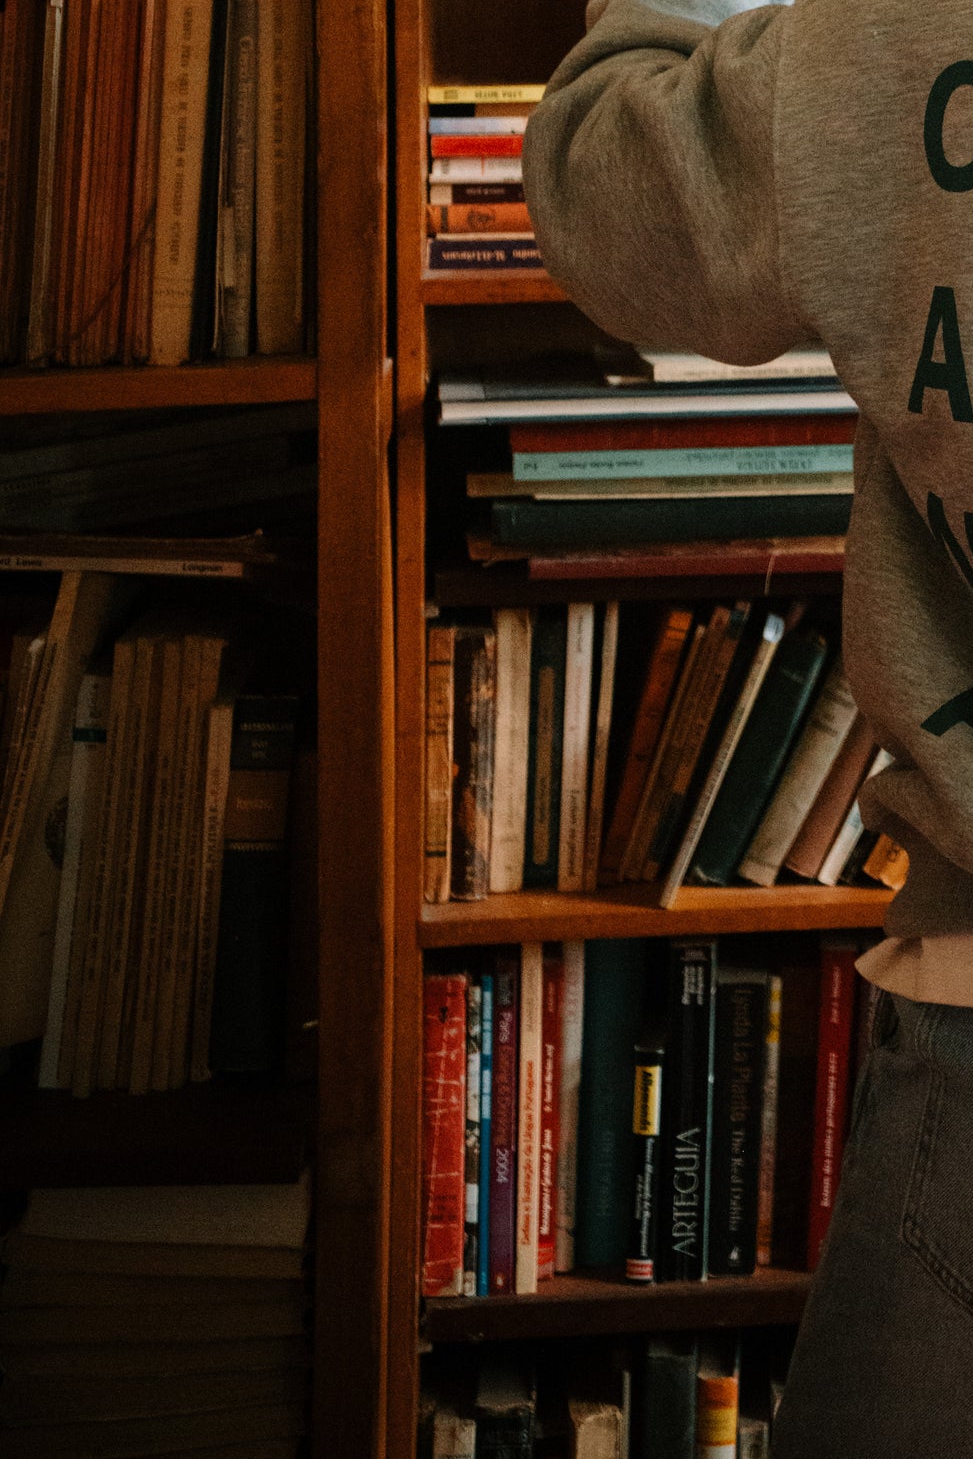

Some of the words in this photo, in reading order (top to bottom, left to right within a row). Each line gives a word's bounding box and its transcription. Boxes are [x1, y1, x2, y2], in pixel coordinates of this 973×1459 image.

[499, 1011, 513, 1044] Paris
[495, 1148, 510, 1184] 2004
[671, 1126, 702, 1259] ARTEGUIA
